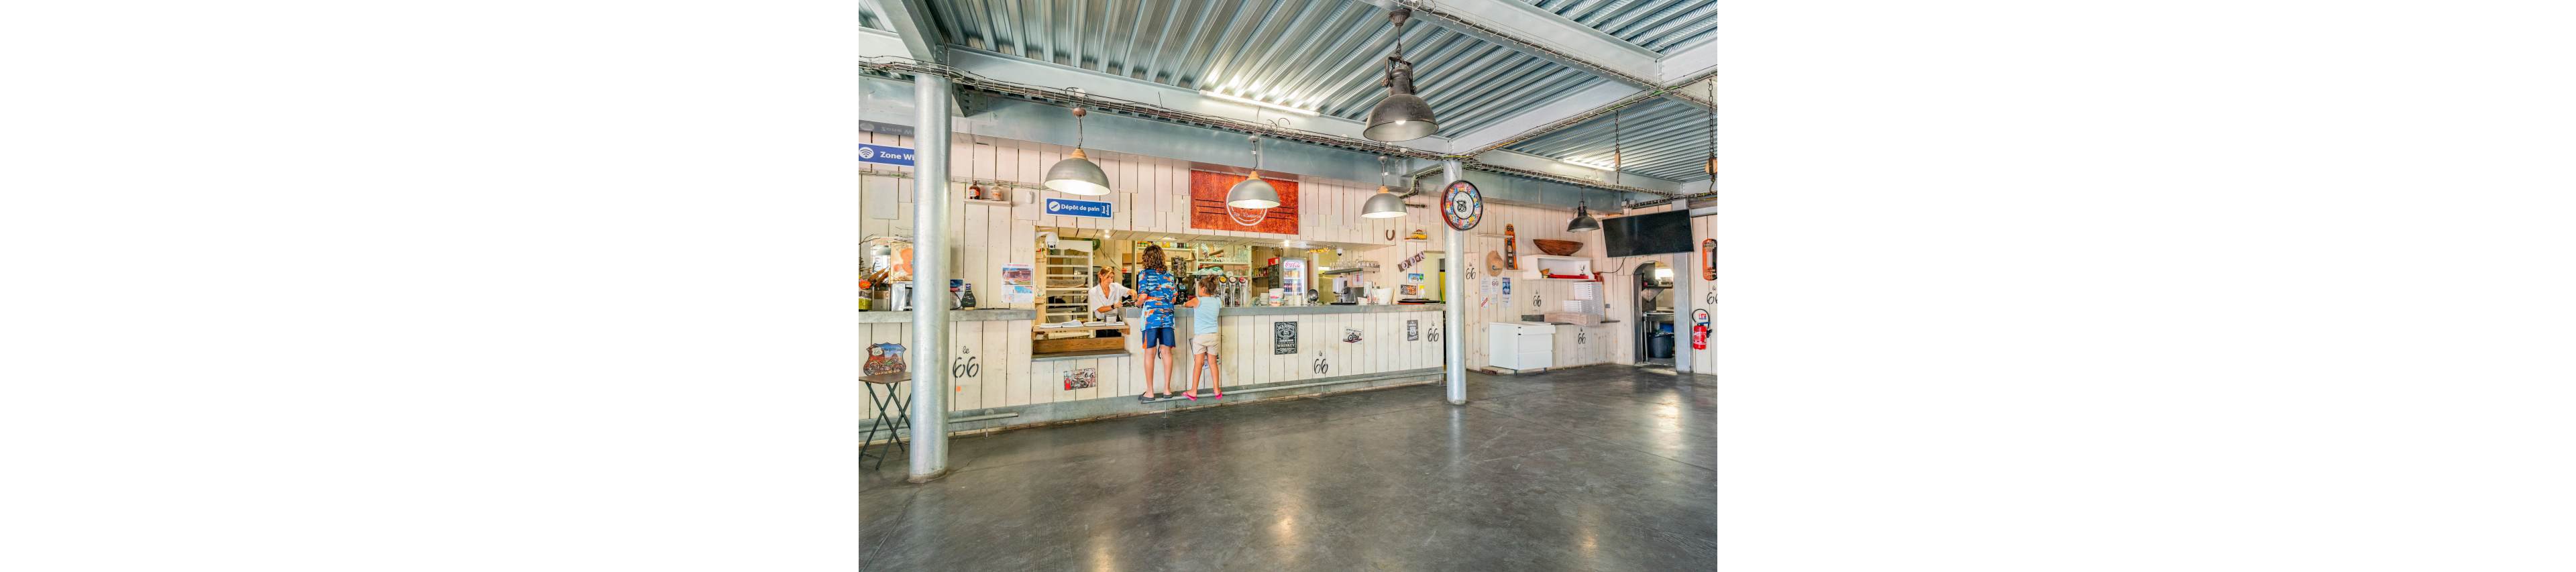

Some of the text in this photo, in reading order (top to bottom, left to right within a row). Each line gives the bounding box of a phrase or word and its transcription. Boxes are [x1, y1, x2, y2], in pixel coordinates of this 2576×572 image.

[880, 151, 902, 160] Zone
[1466, 268, 1476, 280] 66
[1533, 295, 1542, 307] 66
[1428, 328, 1439, 342] 66
[1578, 333, 1586, 345] 66
[963, 345, 970, 354] le
[953, 356, 979, 378] 66
[1313, 358, 1328, 374] 66
